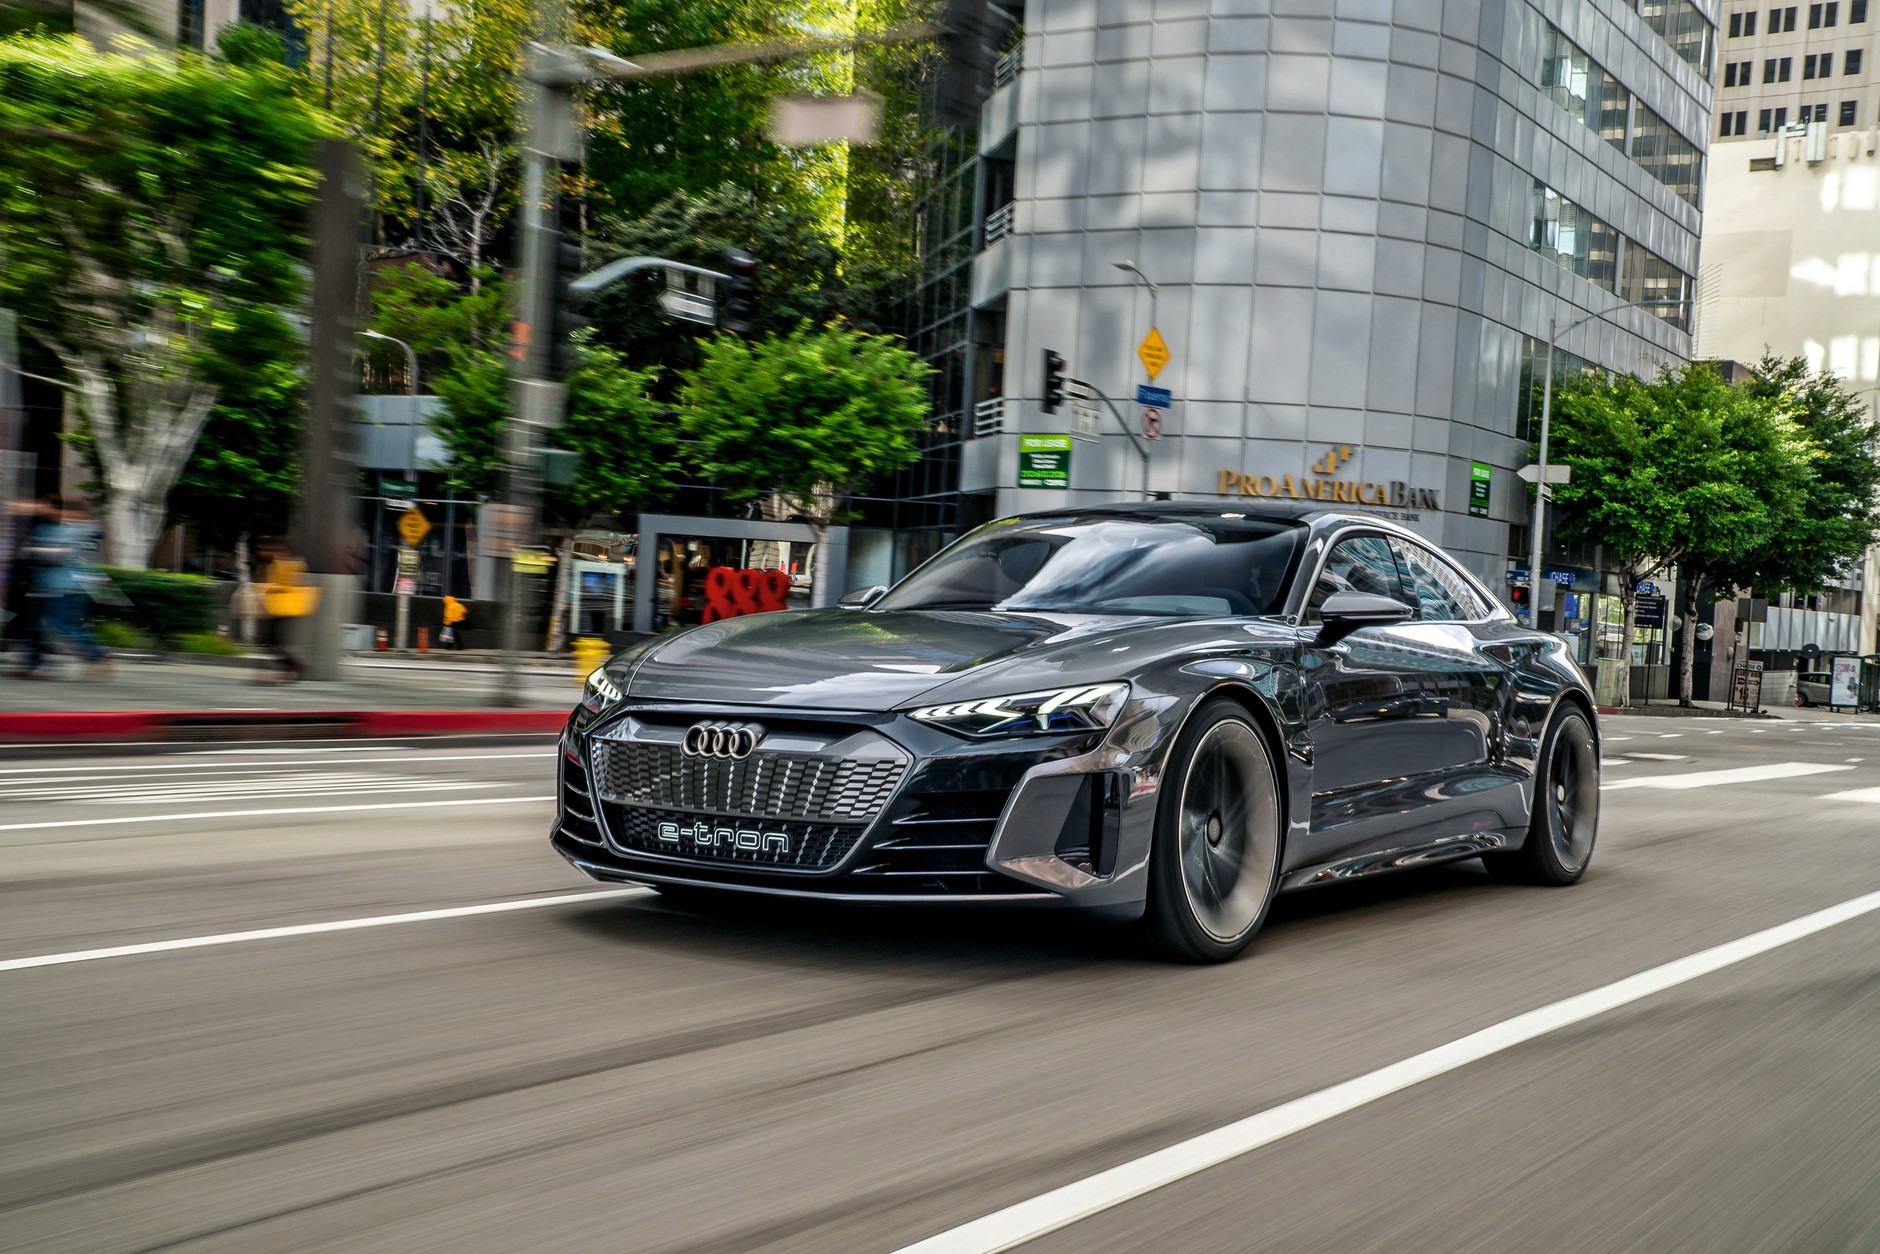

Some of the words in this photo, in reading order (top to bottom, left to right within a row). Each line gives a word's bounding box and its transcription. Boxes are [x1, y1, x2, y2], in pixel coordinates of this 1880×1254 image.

[1401, 512, 1420, 522] BANK
[1551, 571, 1570, 585] CHASE
[658, 821, 789, 853] e-tron
